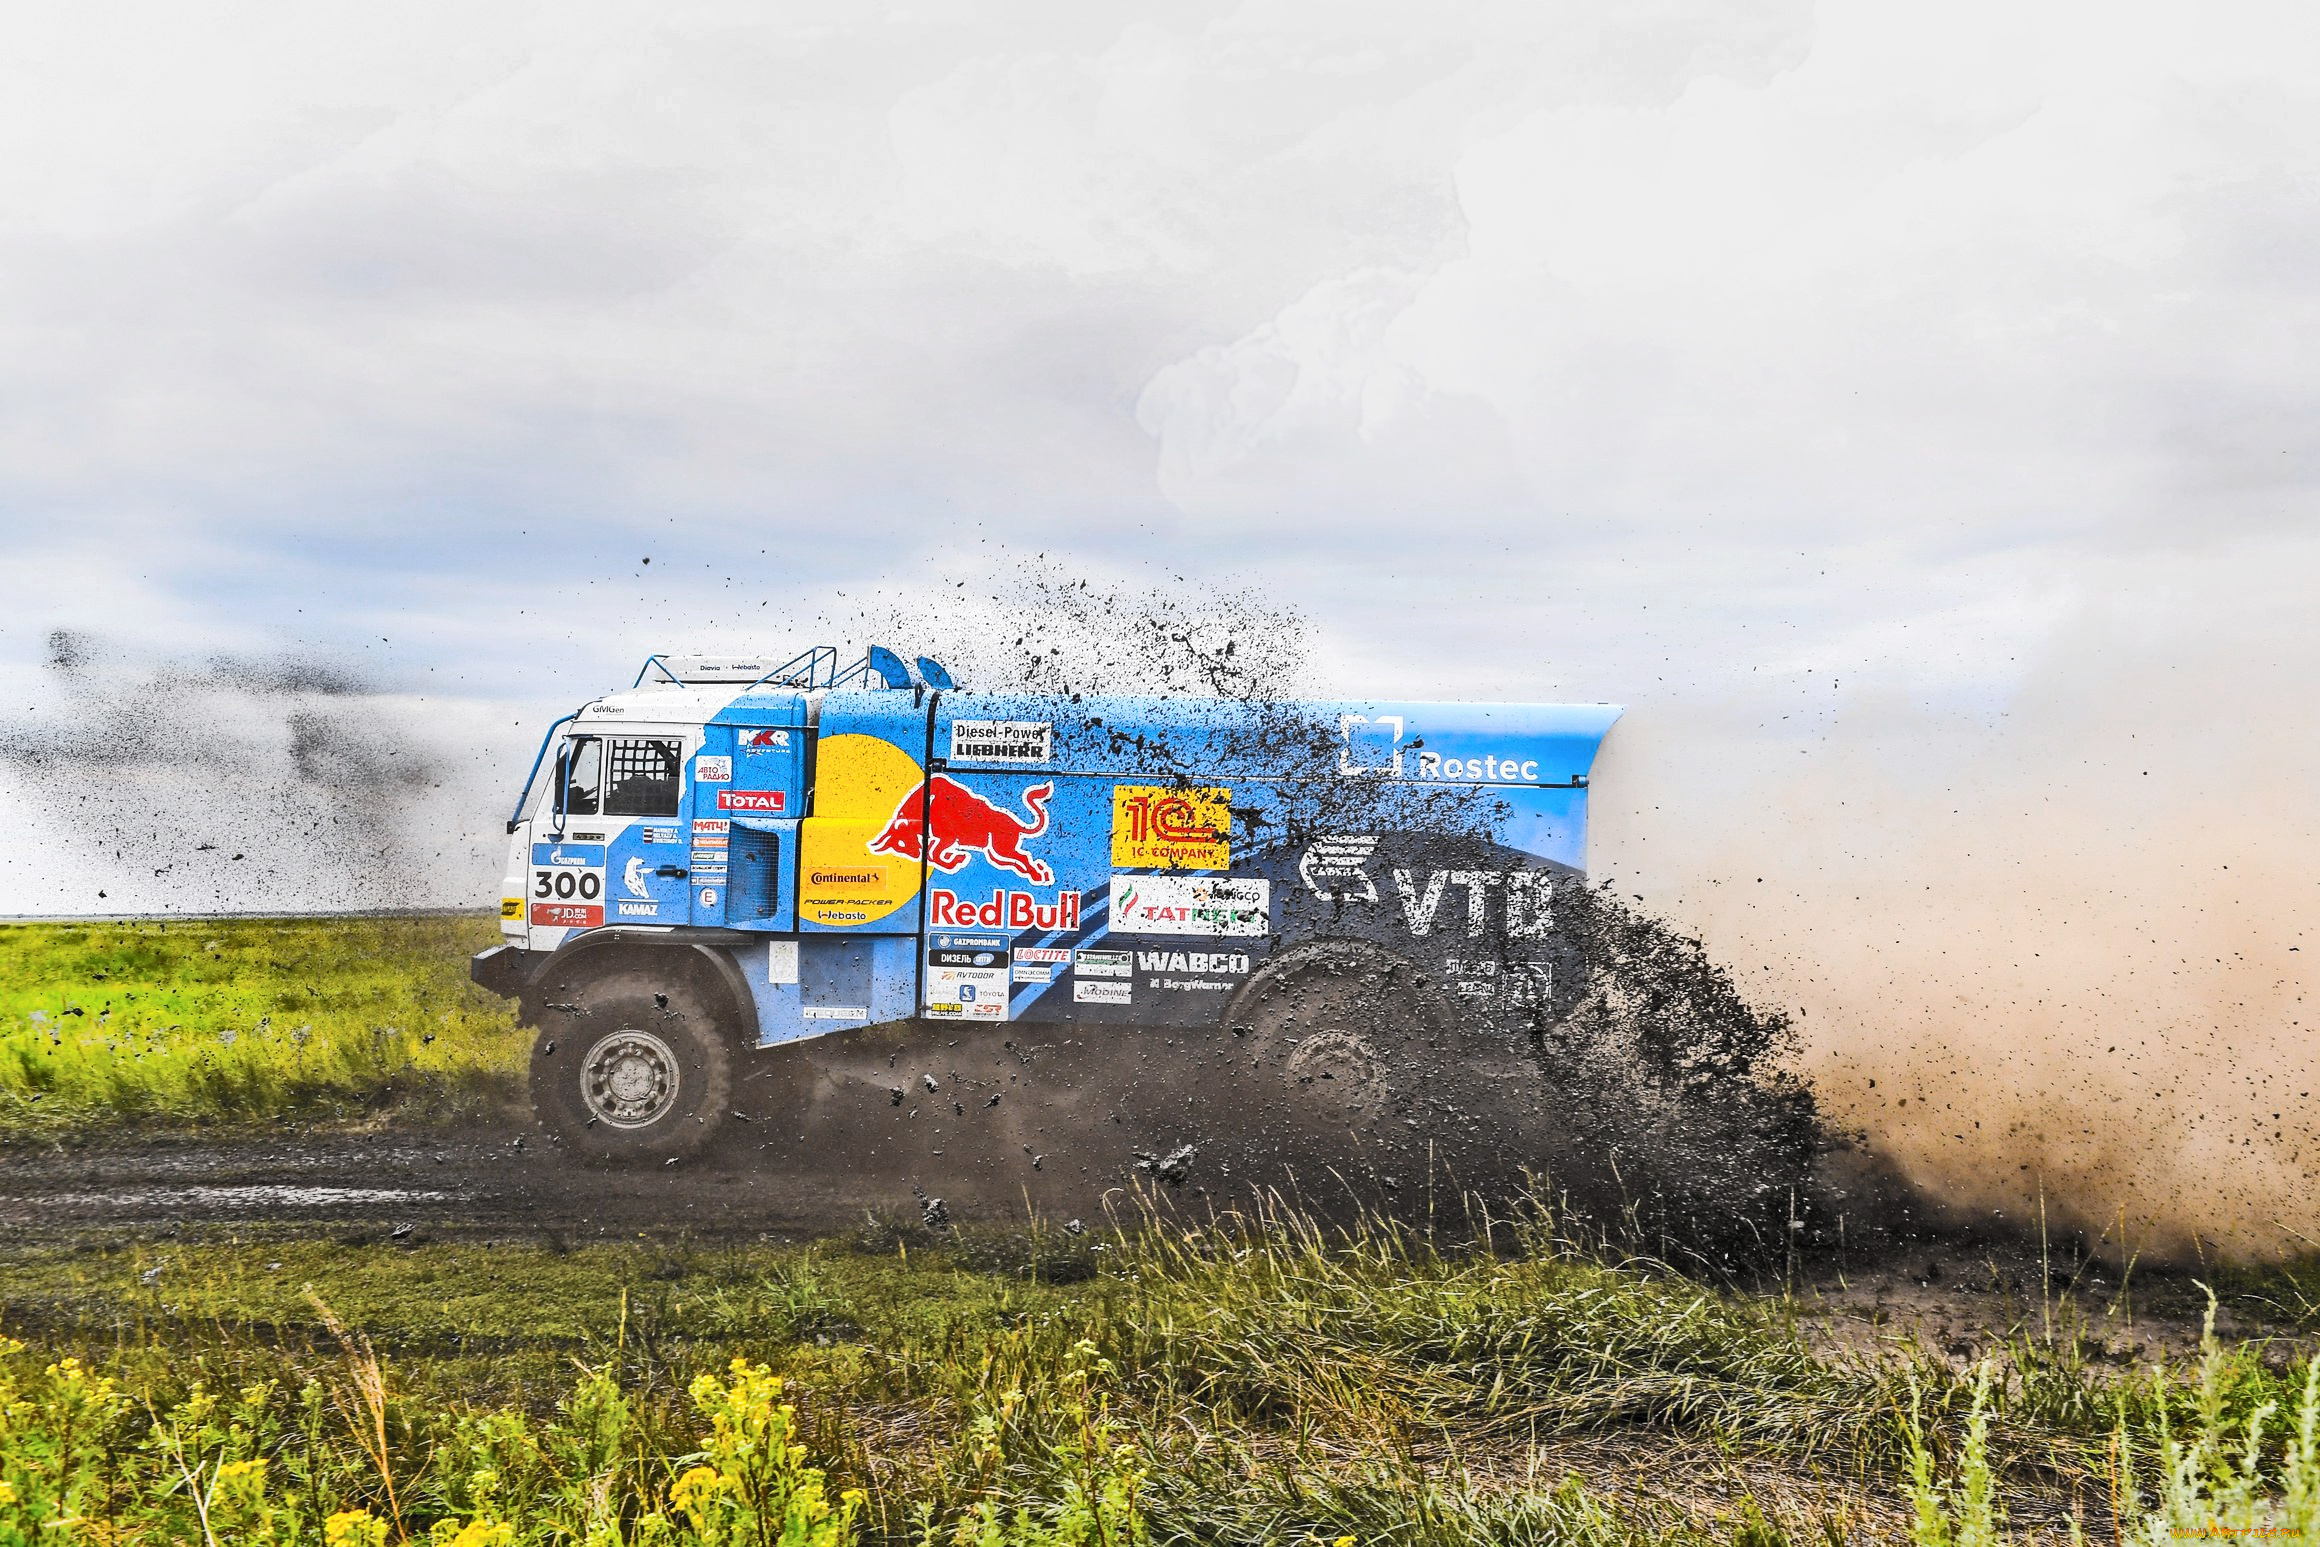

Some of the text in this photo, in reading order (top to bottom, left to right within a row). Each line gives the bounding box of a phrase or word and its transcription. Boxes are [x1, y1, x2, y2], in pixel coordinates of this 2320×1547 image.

[957, 724, 1045, 741] Diesel-Power
[956, 743, 1044, 758] LIEBHERR
[697, 766, 719, 774] АВТО
[1419, 752, 1539, 780] Rostec
[721, 793, 782, 808] TOTAL
[1151, 847, 1215, 859] COMPANY
[810, 872, 870, 884] Continental
[535, 871, 600, 900] 300
[704, 891, 713, 903] E
[618, 903, 658, 916] KAMAZ
[818, 910, 866, 920] Webasto
[931, 890, 1079, 928] Red Bull
[953, 938, 1001, 947] GAZPROMBANK
[1016, 949, 1069, 960] LOCTITE
[1136, 951, 1250, 974] WABCO
